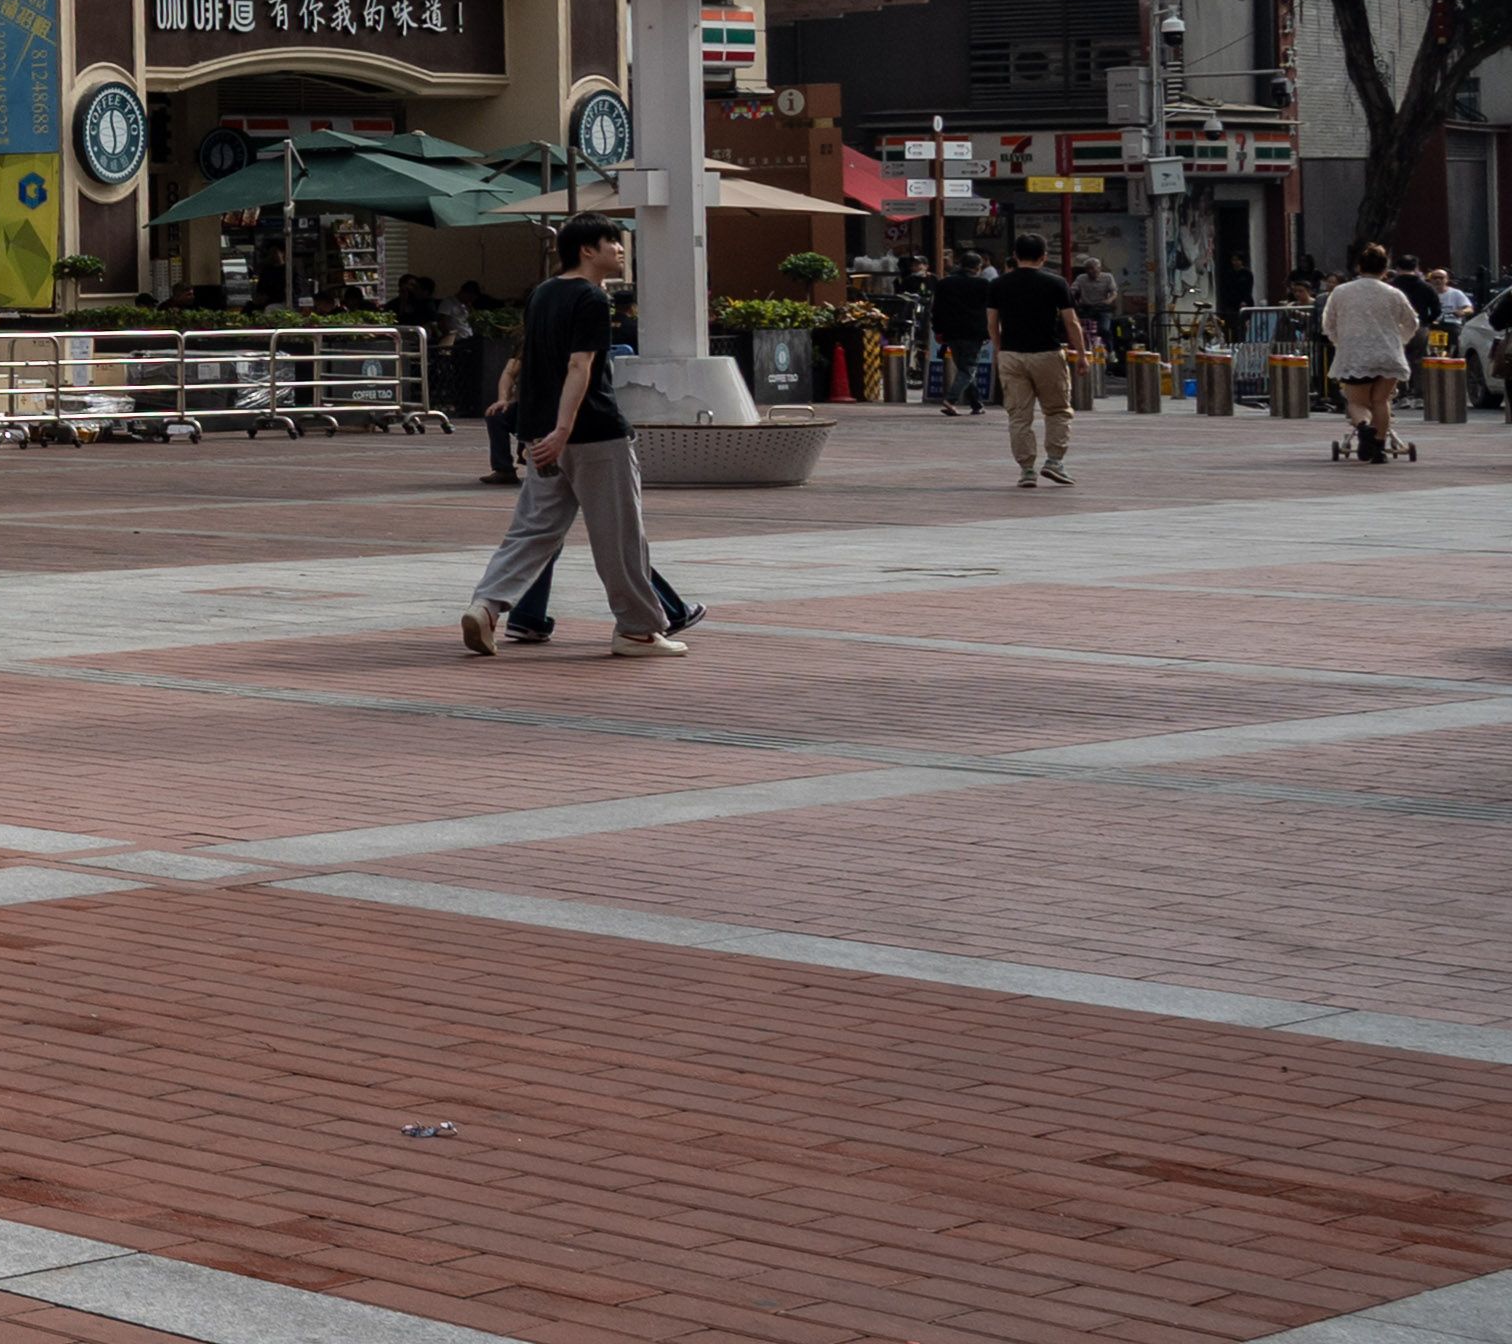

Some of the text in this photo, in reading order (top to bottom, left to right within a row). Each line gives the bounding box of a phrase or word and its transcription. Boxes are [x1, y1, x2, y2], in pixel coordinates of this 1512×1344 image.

[32, 48, 51, 136] 81248688
[89, 94, 140, 138] COFFEE TAO
[584, 100, 626, 140] COFFEE TAO
[351, 388, 394, 401] COFFEE TAO
